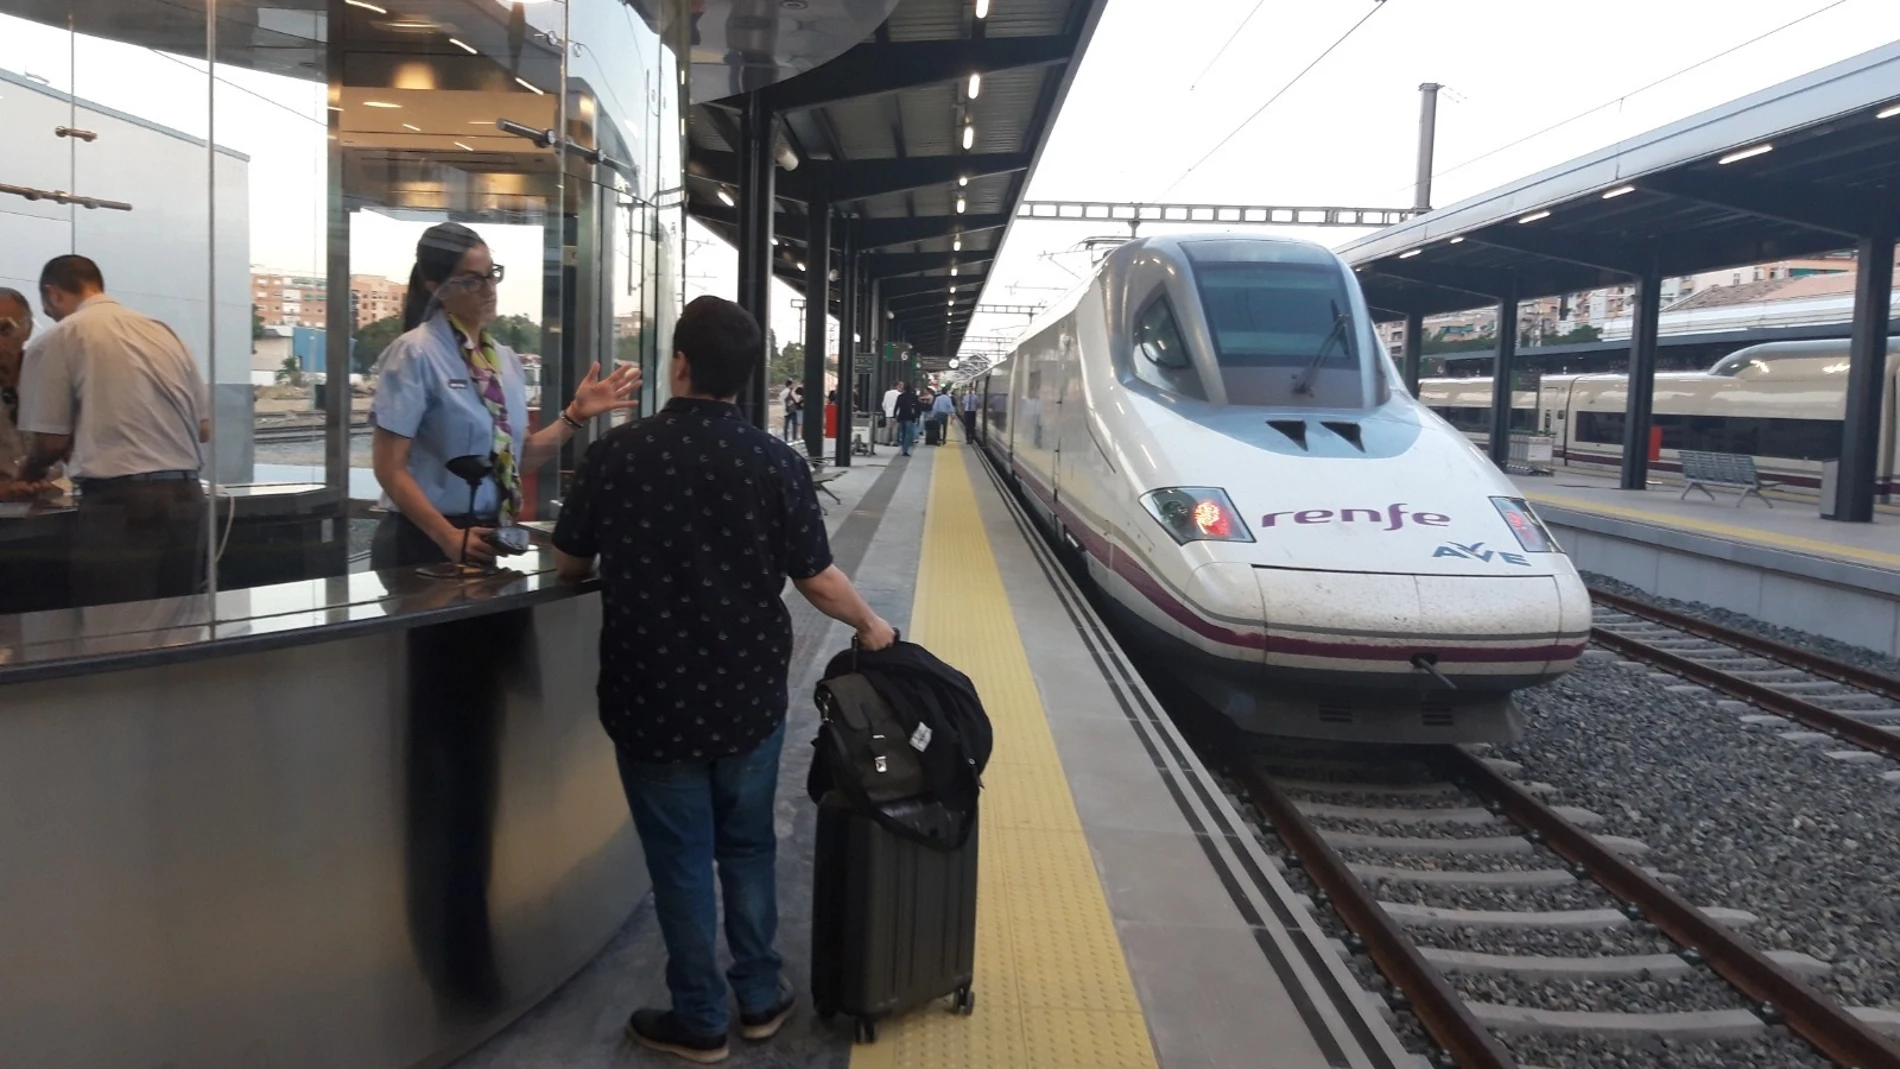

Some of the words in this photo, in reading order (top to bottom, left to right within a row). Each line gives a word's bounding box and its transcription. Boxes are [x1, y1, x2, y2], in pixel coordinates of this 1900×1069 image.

[901, 351, 908, 360] 6
[1261, 503, 1451, 531] renfe
[1431, 541, 1531, 567] AVE
